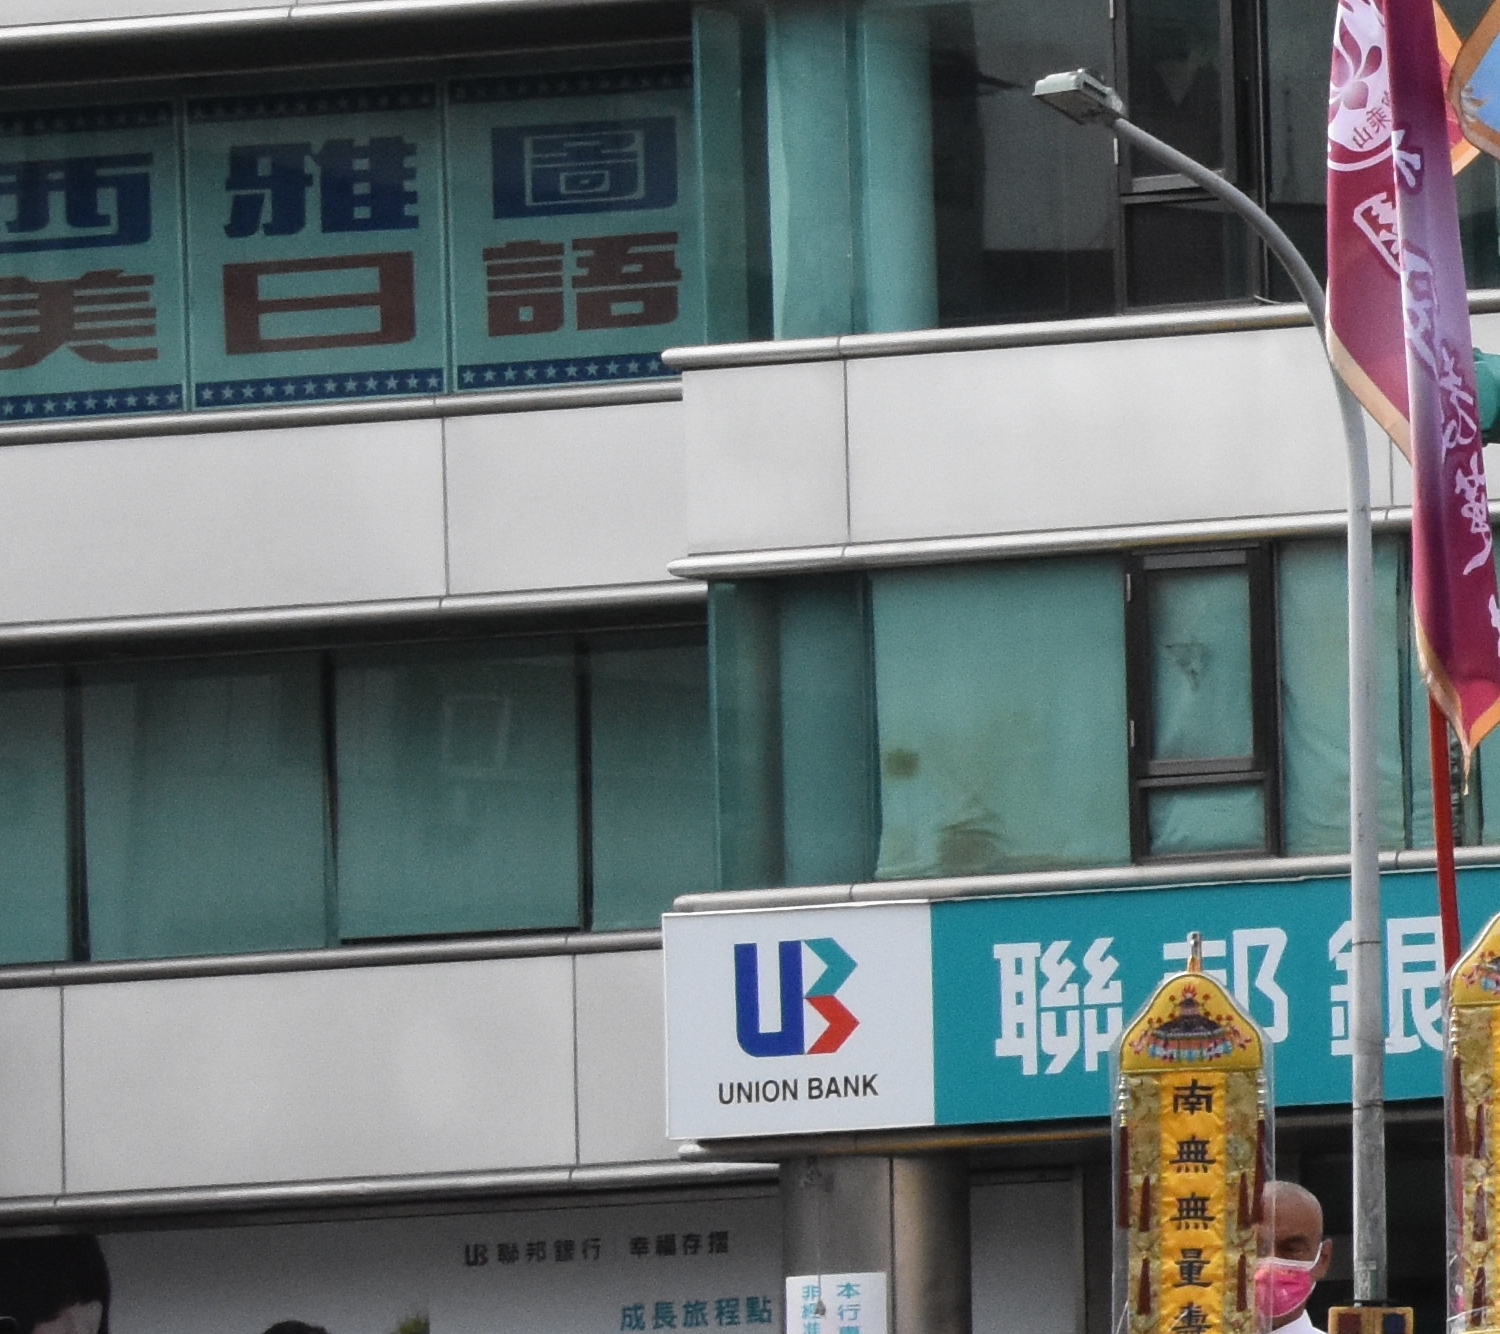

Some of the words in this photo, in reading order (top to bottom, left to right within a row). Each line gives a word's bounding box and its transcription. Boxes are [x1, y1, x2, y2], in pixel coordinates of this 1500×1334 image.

[0, 116, 680, 254] 西雅圖
[0, 230, 683, 369] 美日語
[717, 1079, 798, 1105] UNION
[806, 1073, 879, 1100] BANK
[497, 1237, 601, 1265] 聯邦銀行
